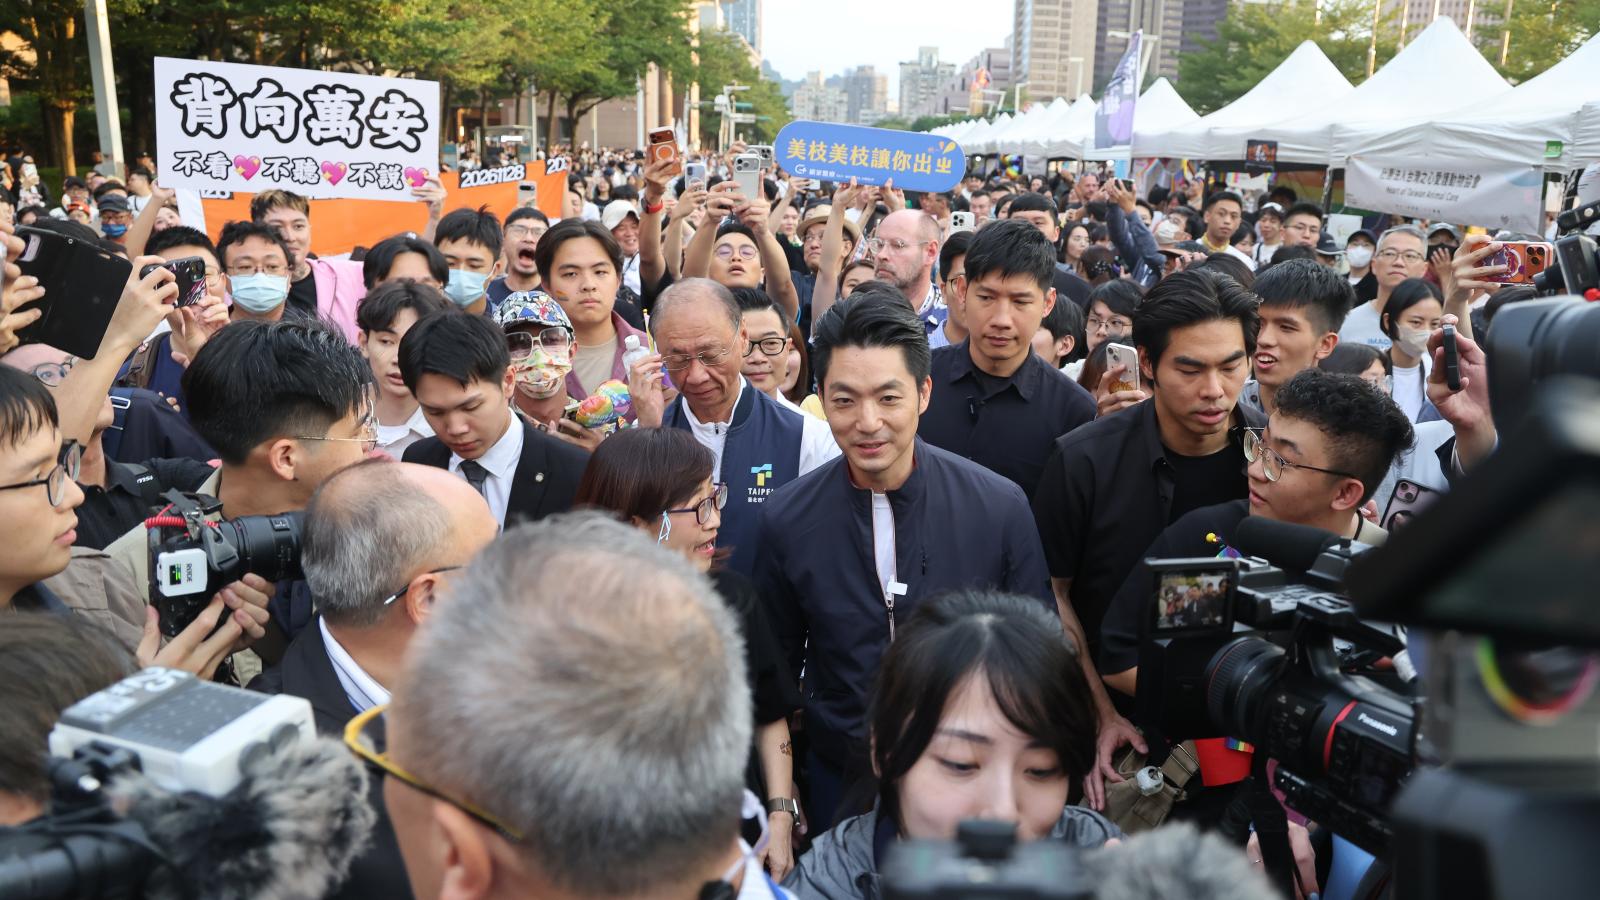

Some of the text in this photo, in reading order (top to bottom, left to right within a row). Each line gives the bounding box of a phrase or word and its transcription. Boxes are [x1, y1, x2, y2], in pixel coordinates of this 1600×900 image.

[169, 72, 429, 153] 背向萬安
[172, 150, 232, 180] 不看
[261, 156, 320, 186] 不聽
[460, 164, 525, 188] 20261128
[1358, 713, 1397, 736] Panasonic
